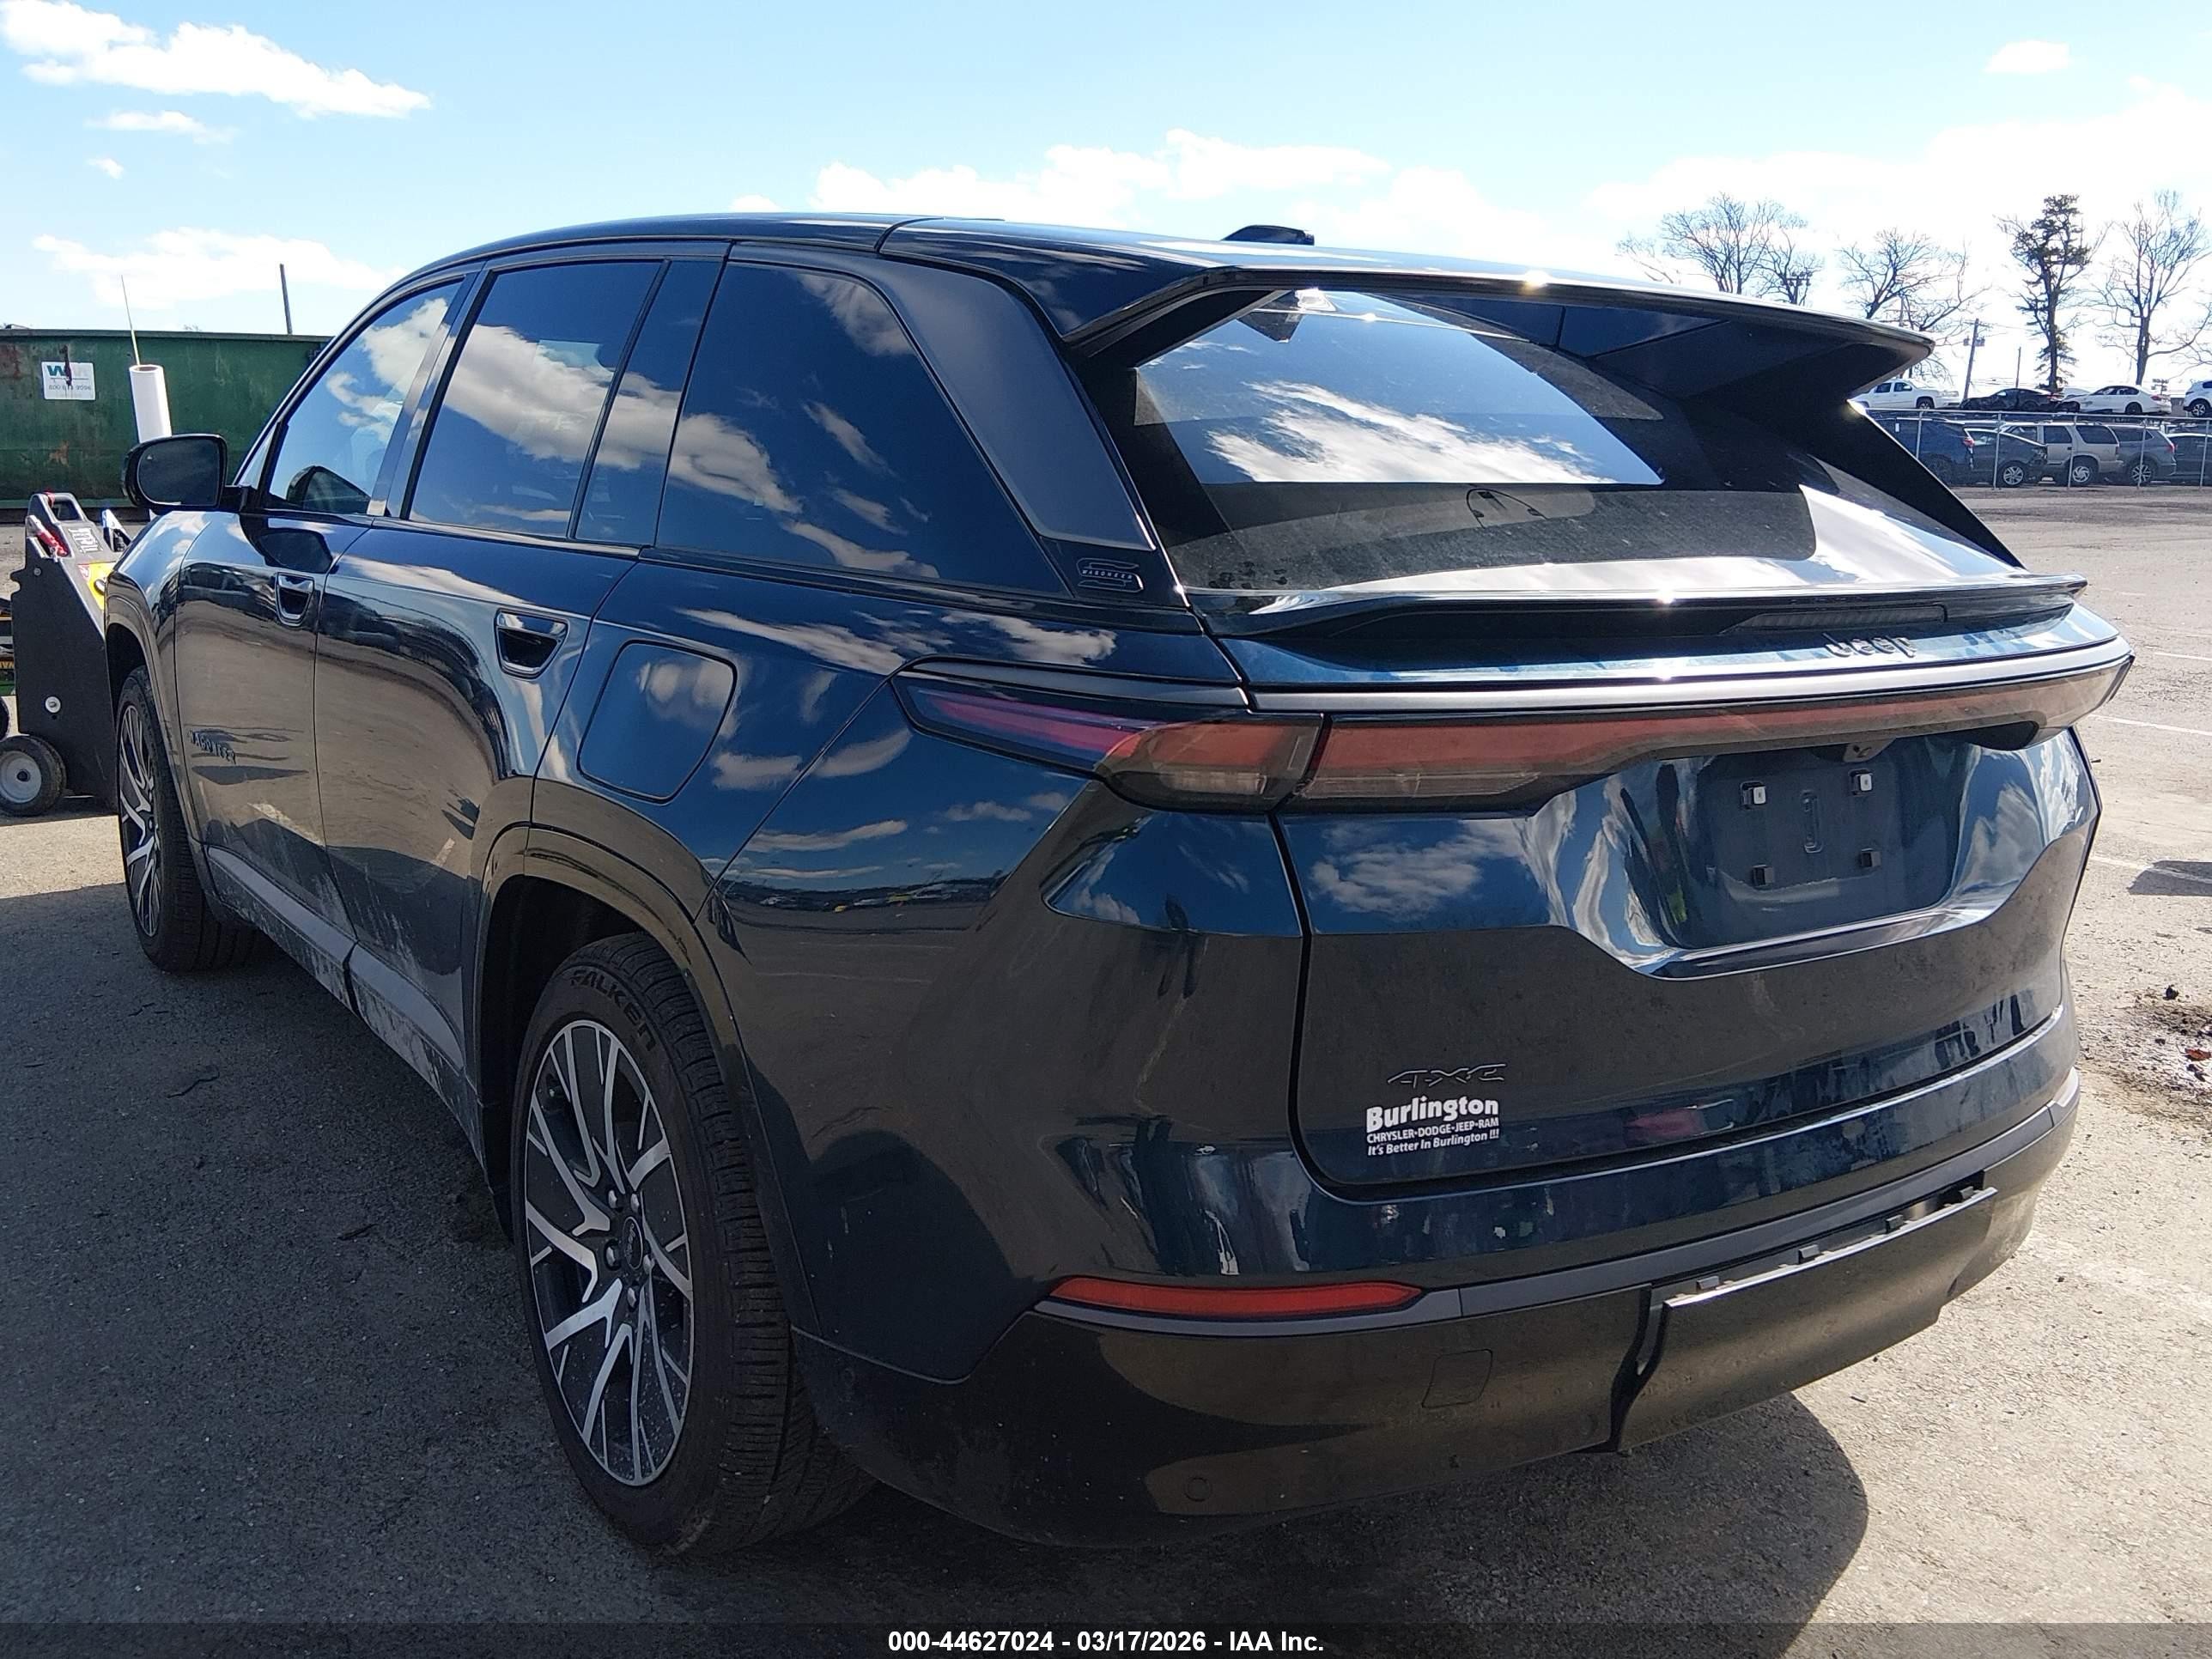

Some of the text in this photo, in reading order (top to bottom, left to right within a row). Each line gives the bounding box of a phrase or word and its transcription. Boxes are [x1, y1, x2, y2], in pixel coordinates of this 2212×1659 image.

[1822, 633, 1917, 658] Jeep
[1366, 1095, 1499, 1133] Burlington
[1367, 1145, 1384, 1157] It's
[1386, 1142, 1419, 1155] Better
[1420, 1139, 1431, 1150] In
[1433, 1132, 1488, 1148] Burlington
